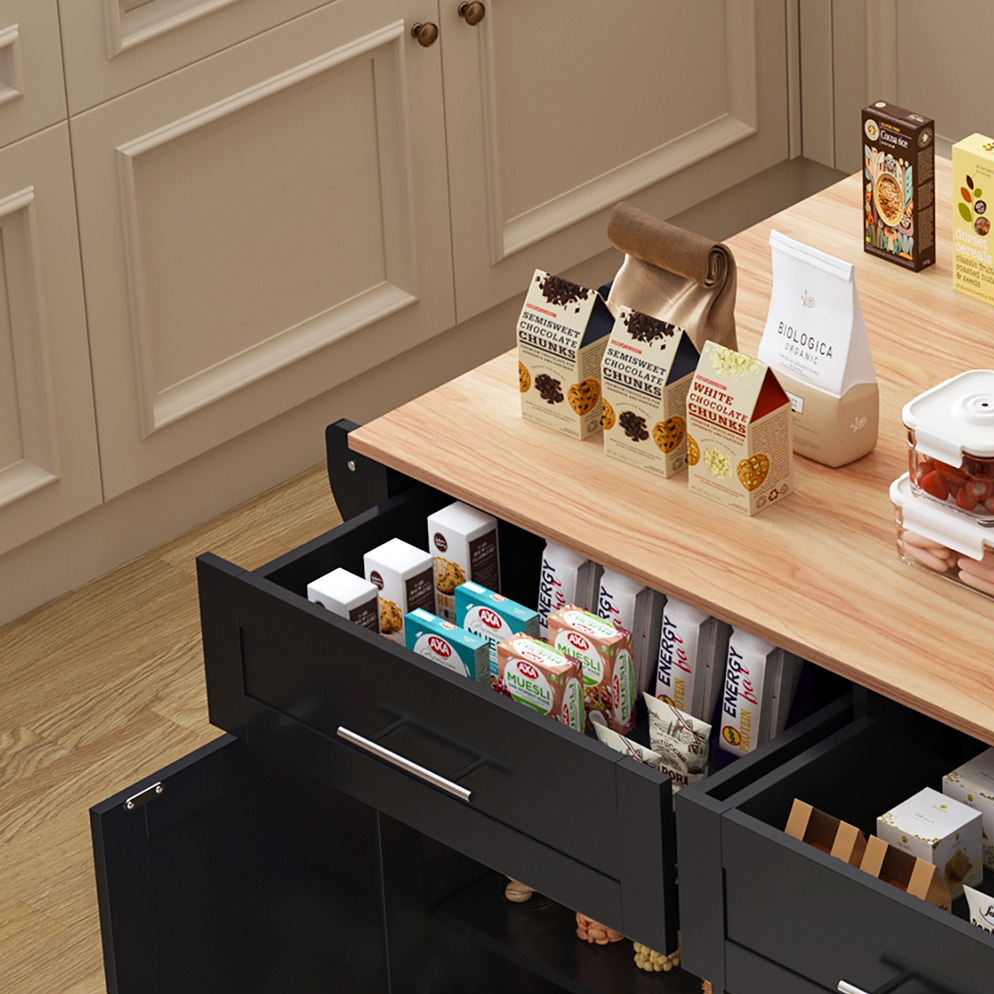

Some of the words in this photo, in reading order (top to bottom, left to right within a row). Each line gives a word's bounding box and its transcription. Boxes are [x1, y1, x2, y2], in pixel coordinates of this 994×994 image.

[955, 227, 988, 250] dorset
[955, 242, 992, 265] cereals
[519, 320, 578, 348] CHOCOLATE
[522, 311, 581, 338] SEMISWEET
[518, 330, 576, 359] CHUNKS
[777, 321, 833, 359] BIOLOGICA
[784, 342, 819, 365] ORGANIC
[604, 358, 664, 386] CHOCOLATE
[607, 348, 666, 376] SEMISWEET
[603, 367, 661, 396] CHUNKS
[693, 382, 734, 406] WHITE
[688, 402, 746, 434] CHUNKS
[689, 393, 748, 423] CHOCOLATE
[539, 559, 556, 629] ENERGY
[598, 586, 613, 619] RGY
[658, 615, 677, 687] ENERGY
[507, 672, 550, 700] MUESLI
[724, 646, 743, 718] ENERGY
[739, 708, 751, 753] PROTEIN
